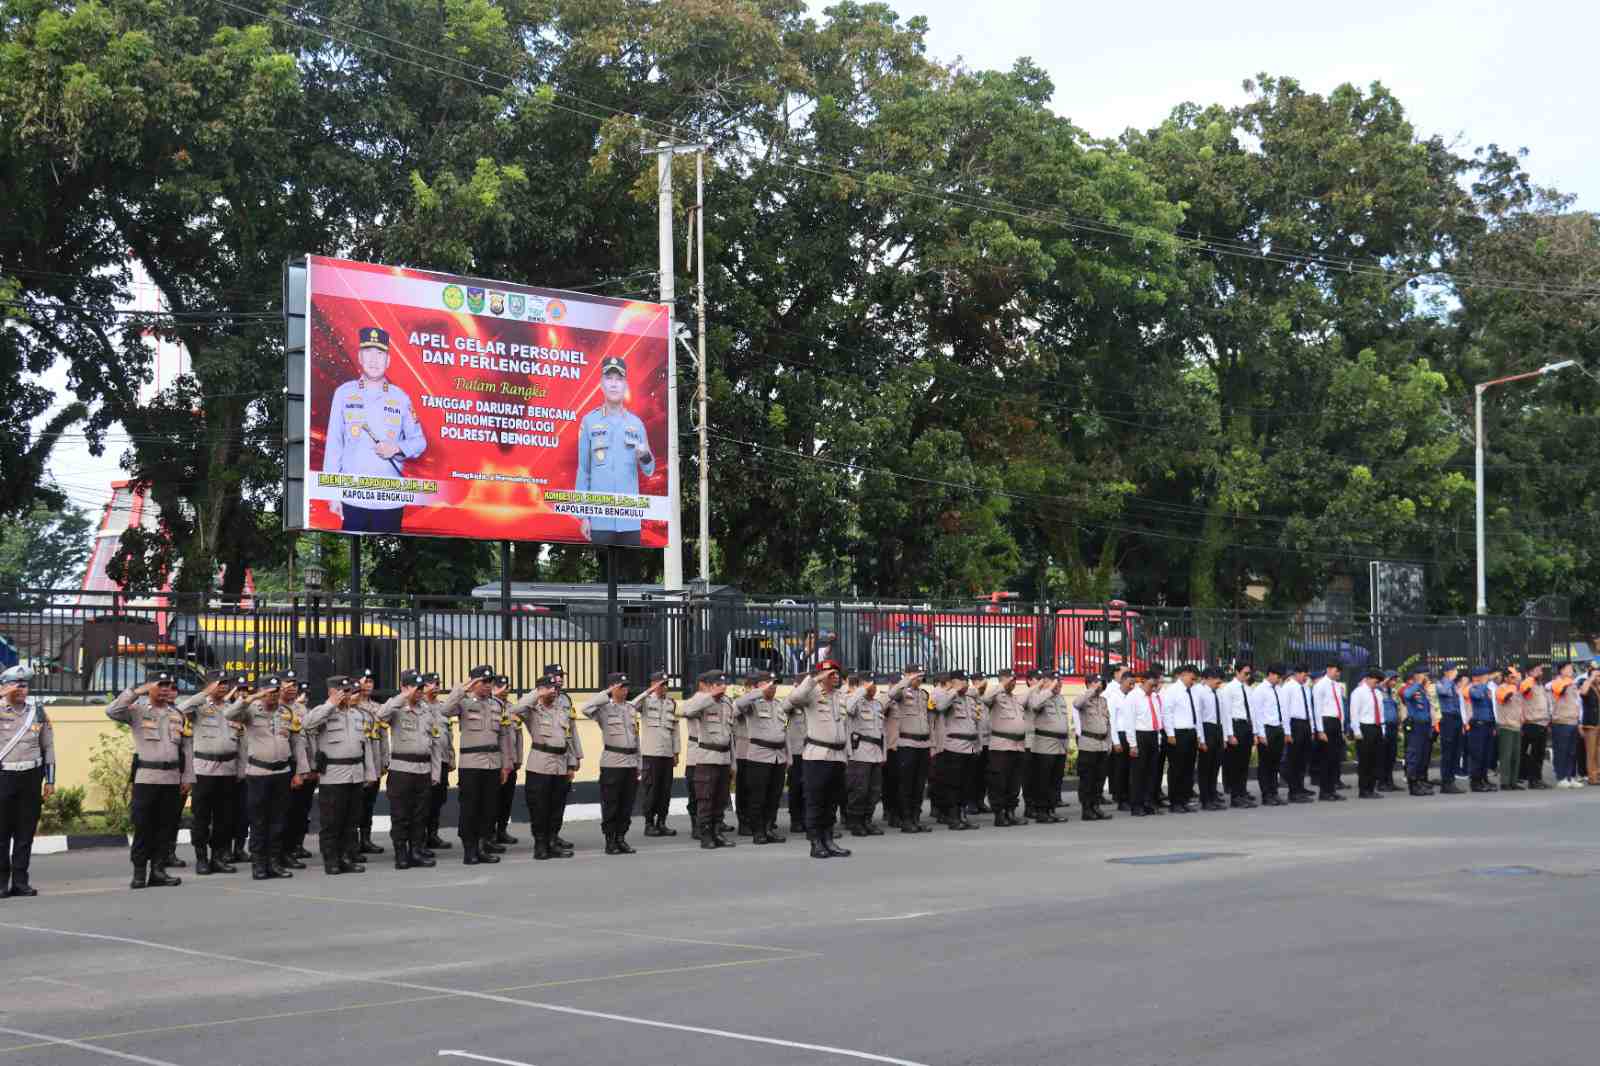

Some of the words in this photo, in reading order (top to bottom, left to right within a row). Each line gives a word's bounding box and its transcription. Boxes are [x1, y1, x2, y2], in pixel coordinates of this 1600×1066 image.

[409, 332, 449, 348] APEL
[455, 337, 505, 356] GELAR
[511, 344, 588, 365] PERSONEL
[422, 350, 455, 365] DAN
[461, 354, 580, 379] PERLENGKAPAN
[455, 378, 496, 393] Dalam
[500, 382, 547, 400] Rangka
[421, 395, 472, 410] TANGGAP
[476, 400, 525, 417] DARURAT
[528, 407, 577, 422] BENCANA
[445, 412, 554, 433] HIDROMETEOROLOGI
[440, 427, 498, 444] POLRESTA
[500, 431, 559, 448] BENGKULU
[342, 489, 375, 500] KAPOLDA
[377, 491, 415, 502] BENGKULU
[555, 504, 603, 515] KAPOLRESTA
[605, 507, 644, 518] BENGKULU
